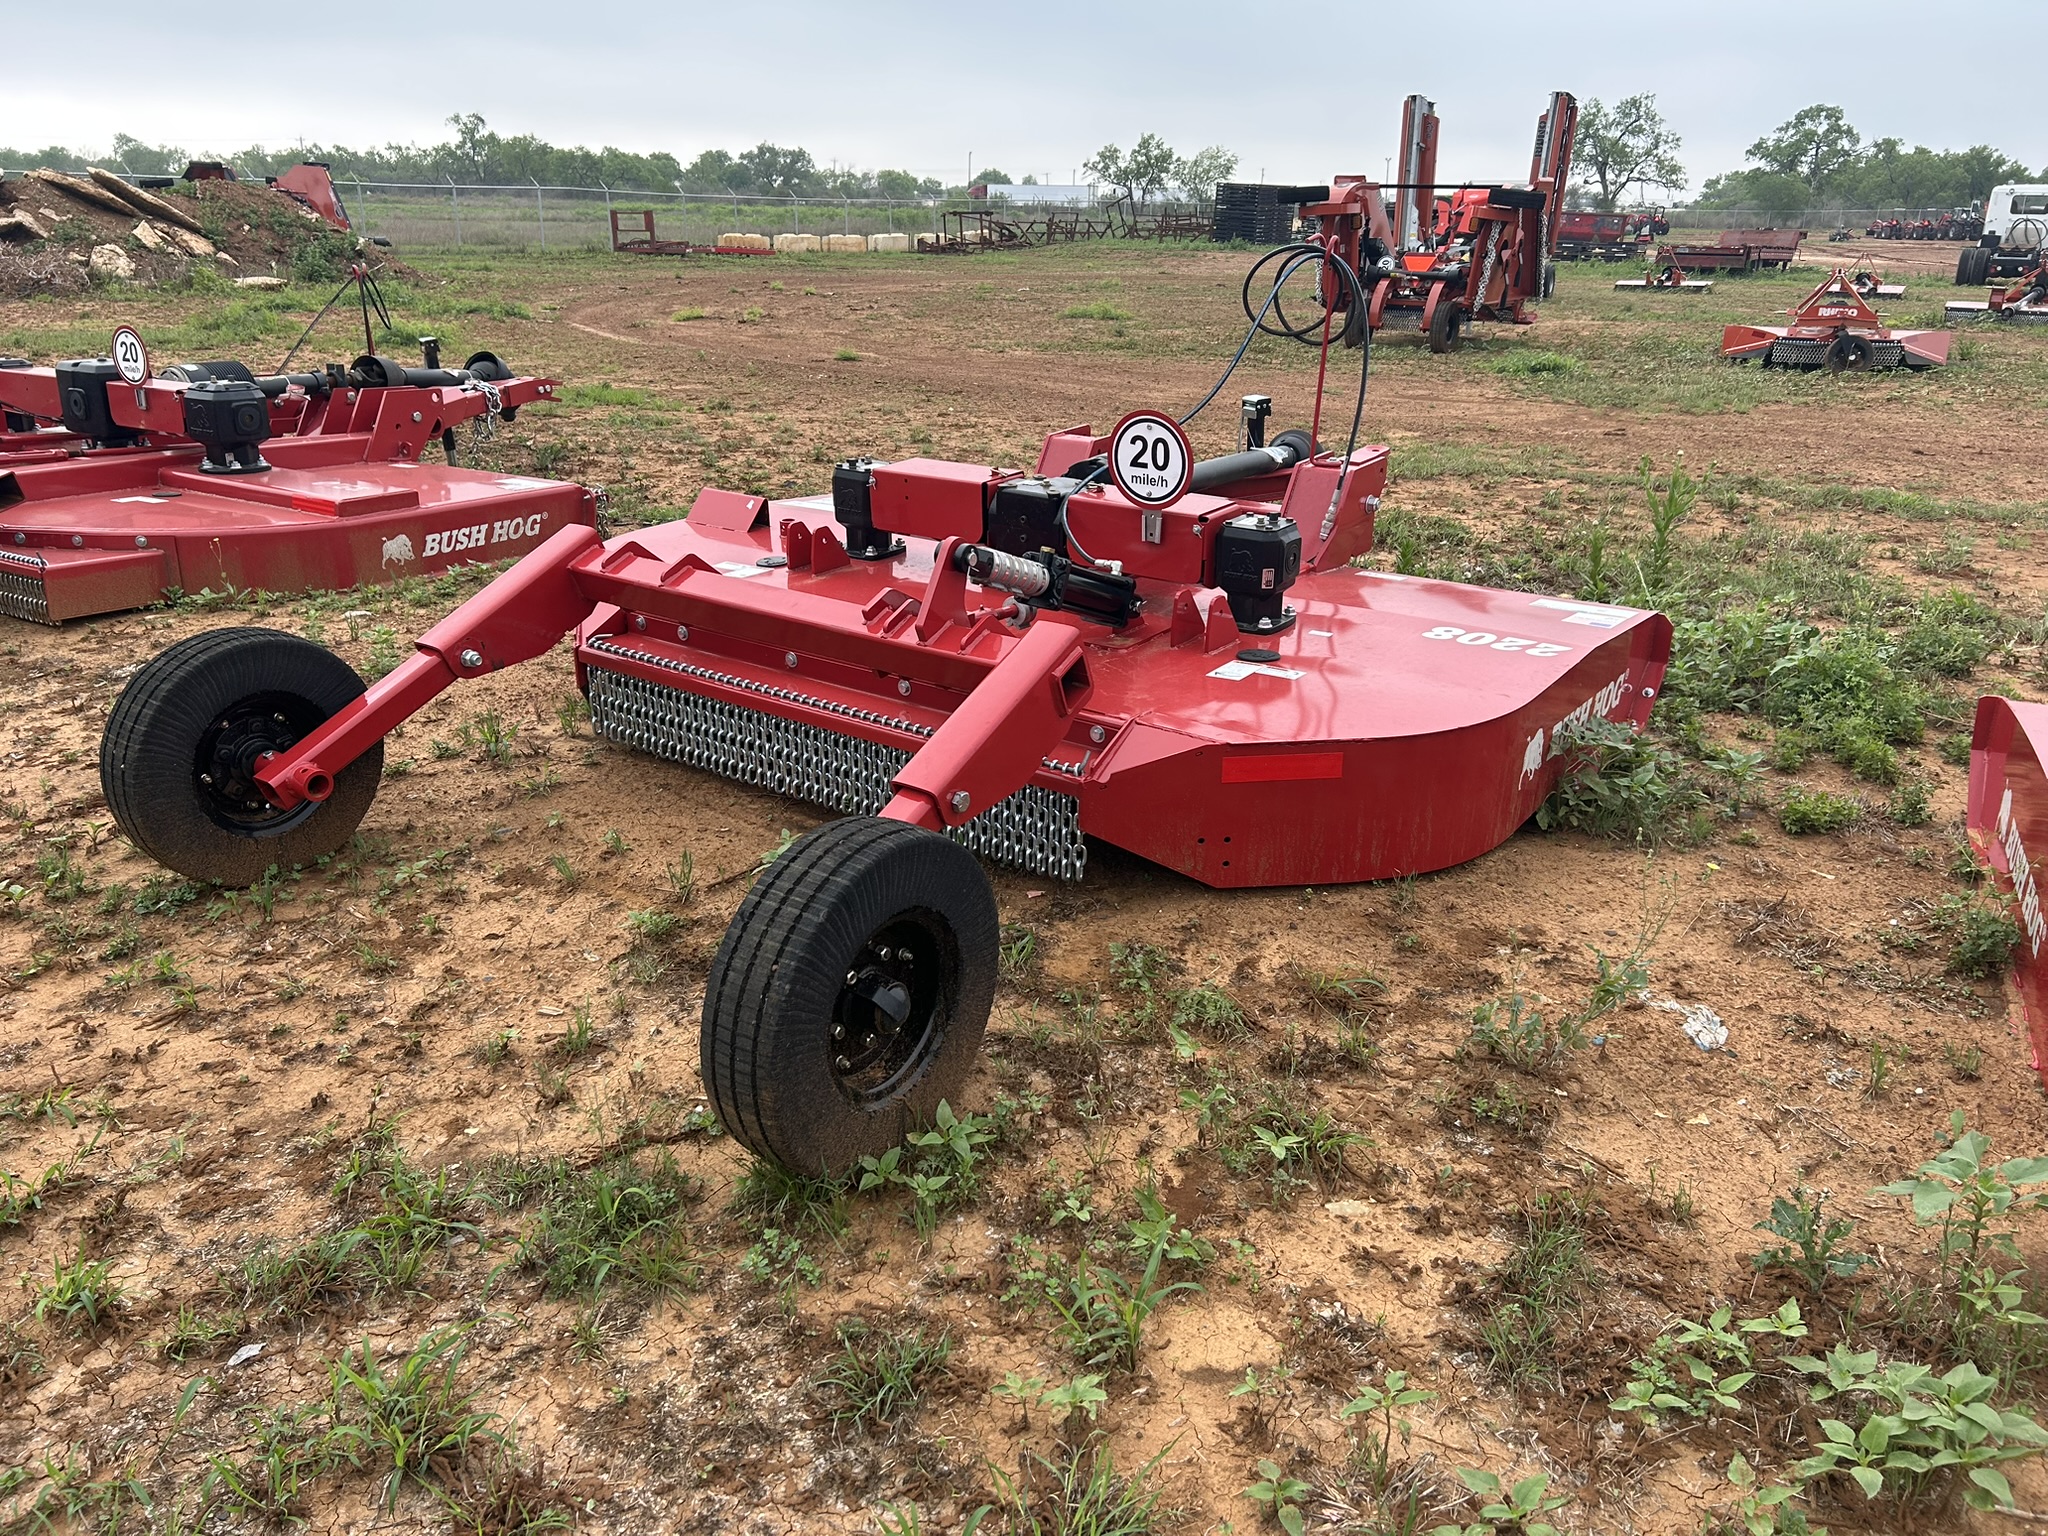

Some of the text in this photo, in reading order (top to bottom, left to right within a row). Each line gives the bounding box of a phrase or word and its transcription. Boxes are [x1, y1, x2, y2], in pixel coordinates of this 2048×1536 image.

[120, 341, 139, 363] 20
[1129, 435, 1170, 472] 20
[1131, 473, 1168, 488] mile/h
[422, 524, 488, 557] BUSH
[1421, 626, 1574, 657] 2208
